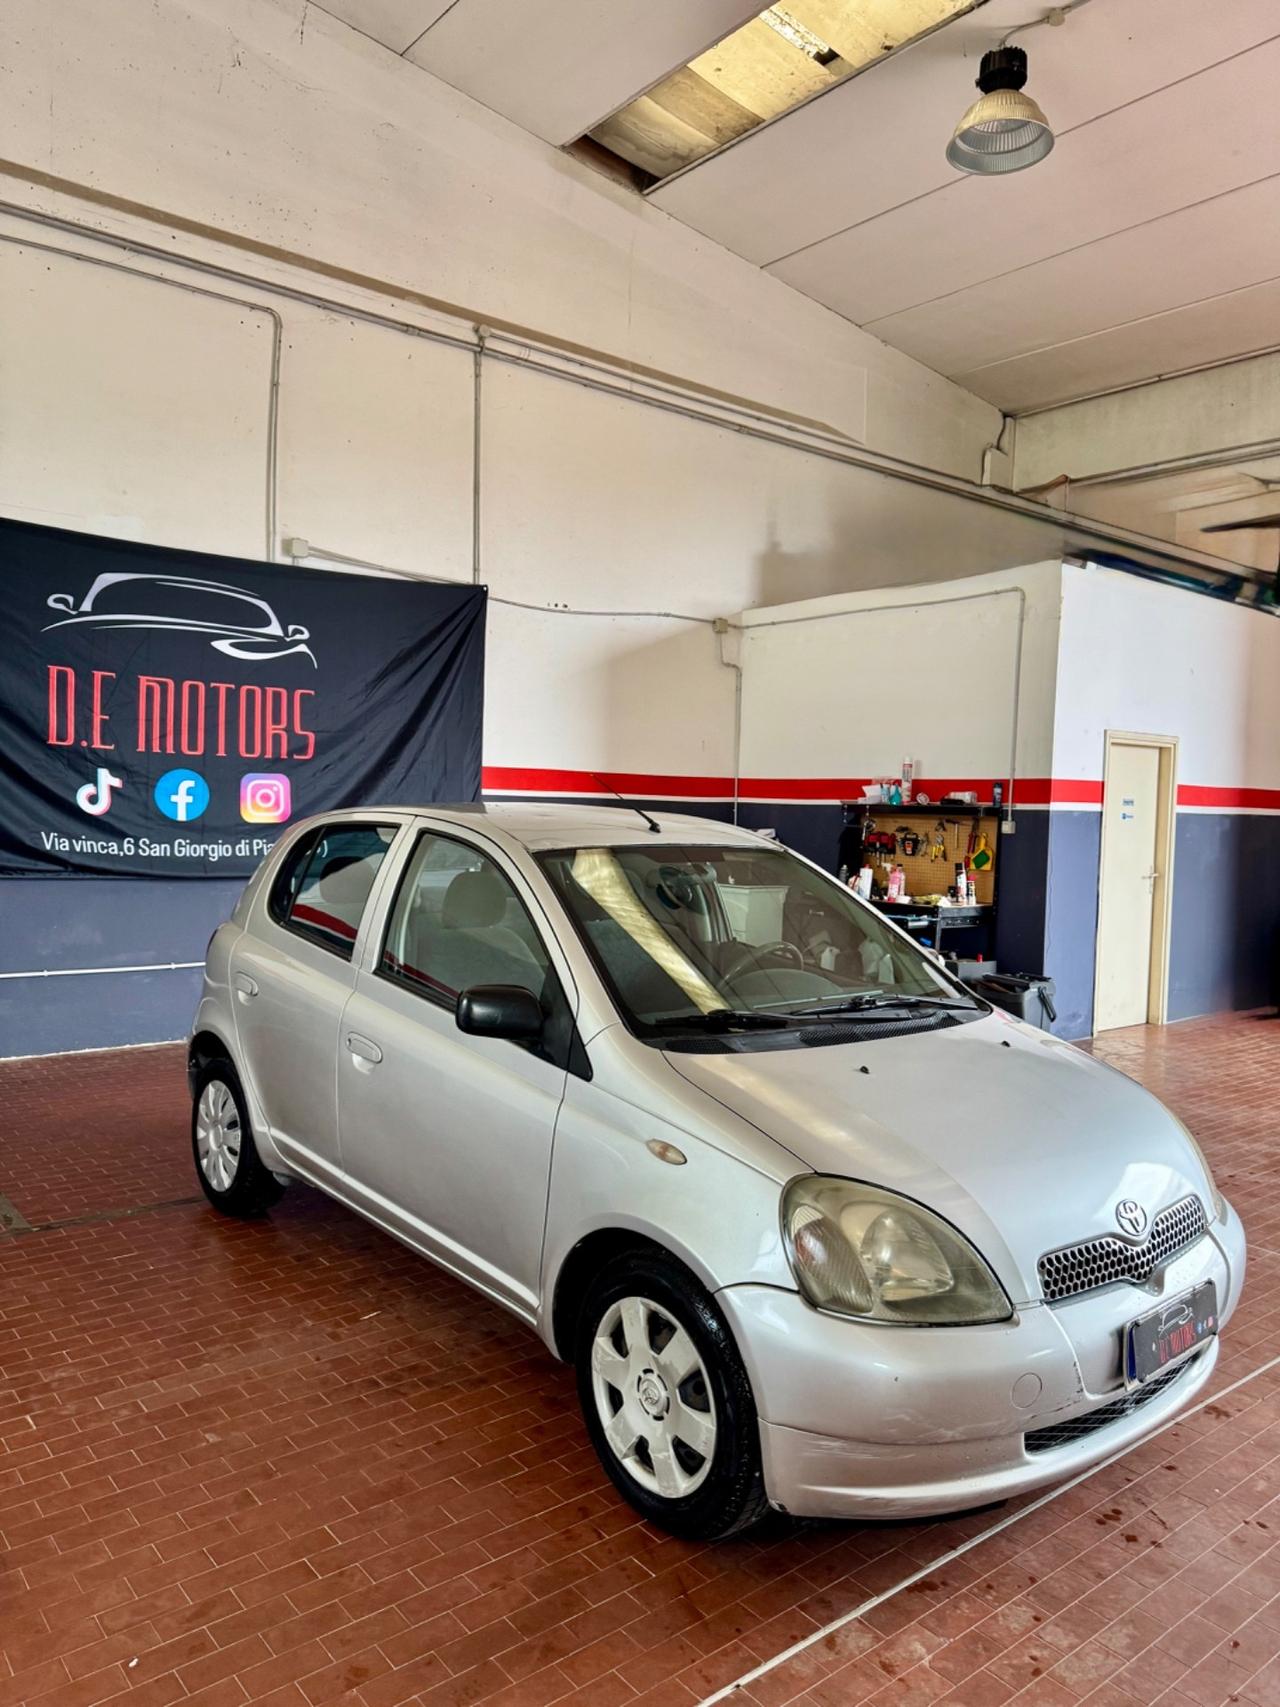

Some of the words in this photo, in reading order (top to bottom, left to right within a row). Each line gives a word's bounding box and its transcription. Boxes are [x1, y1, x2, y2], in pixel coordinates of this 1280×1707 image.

[47, 665, 116, 750] D.E
[136, 675, 316, 760] MOTORS
[41, 831, 70, 851] Via
[72, 835, 135, 856] vinca,6
[138, 838, 171, 857] San
[174, 838, 232, 862] Giorgio
[235, 839, 250, 856] di
[252, 839, 275, 856] Pia
